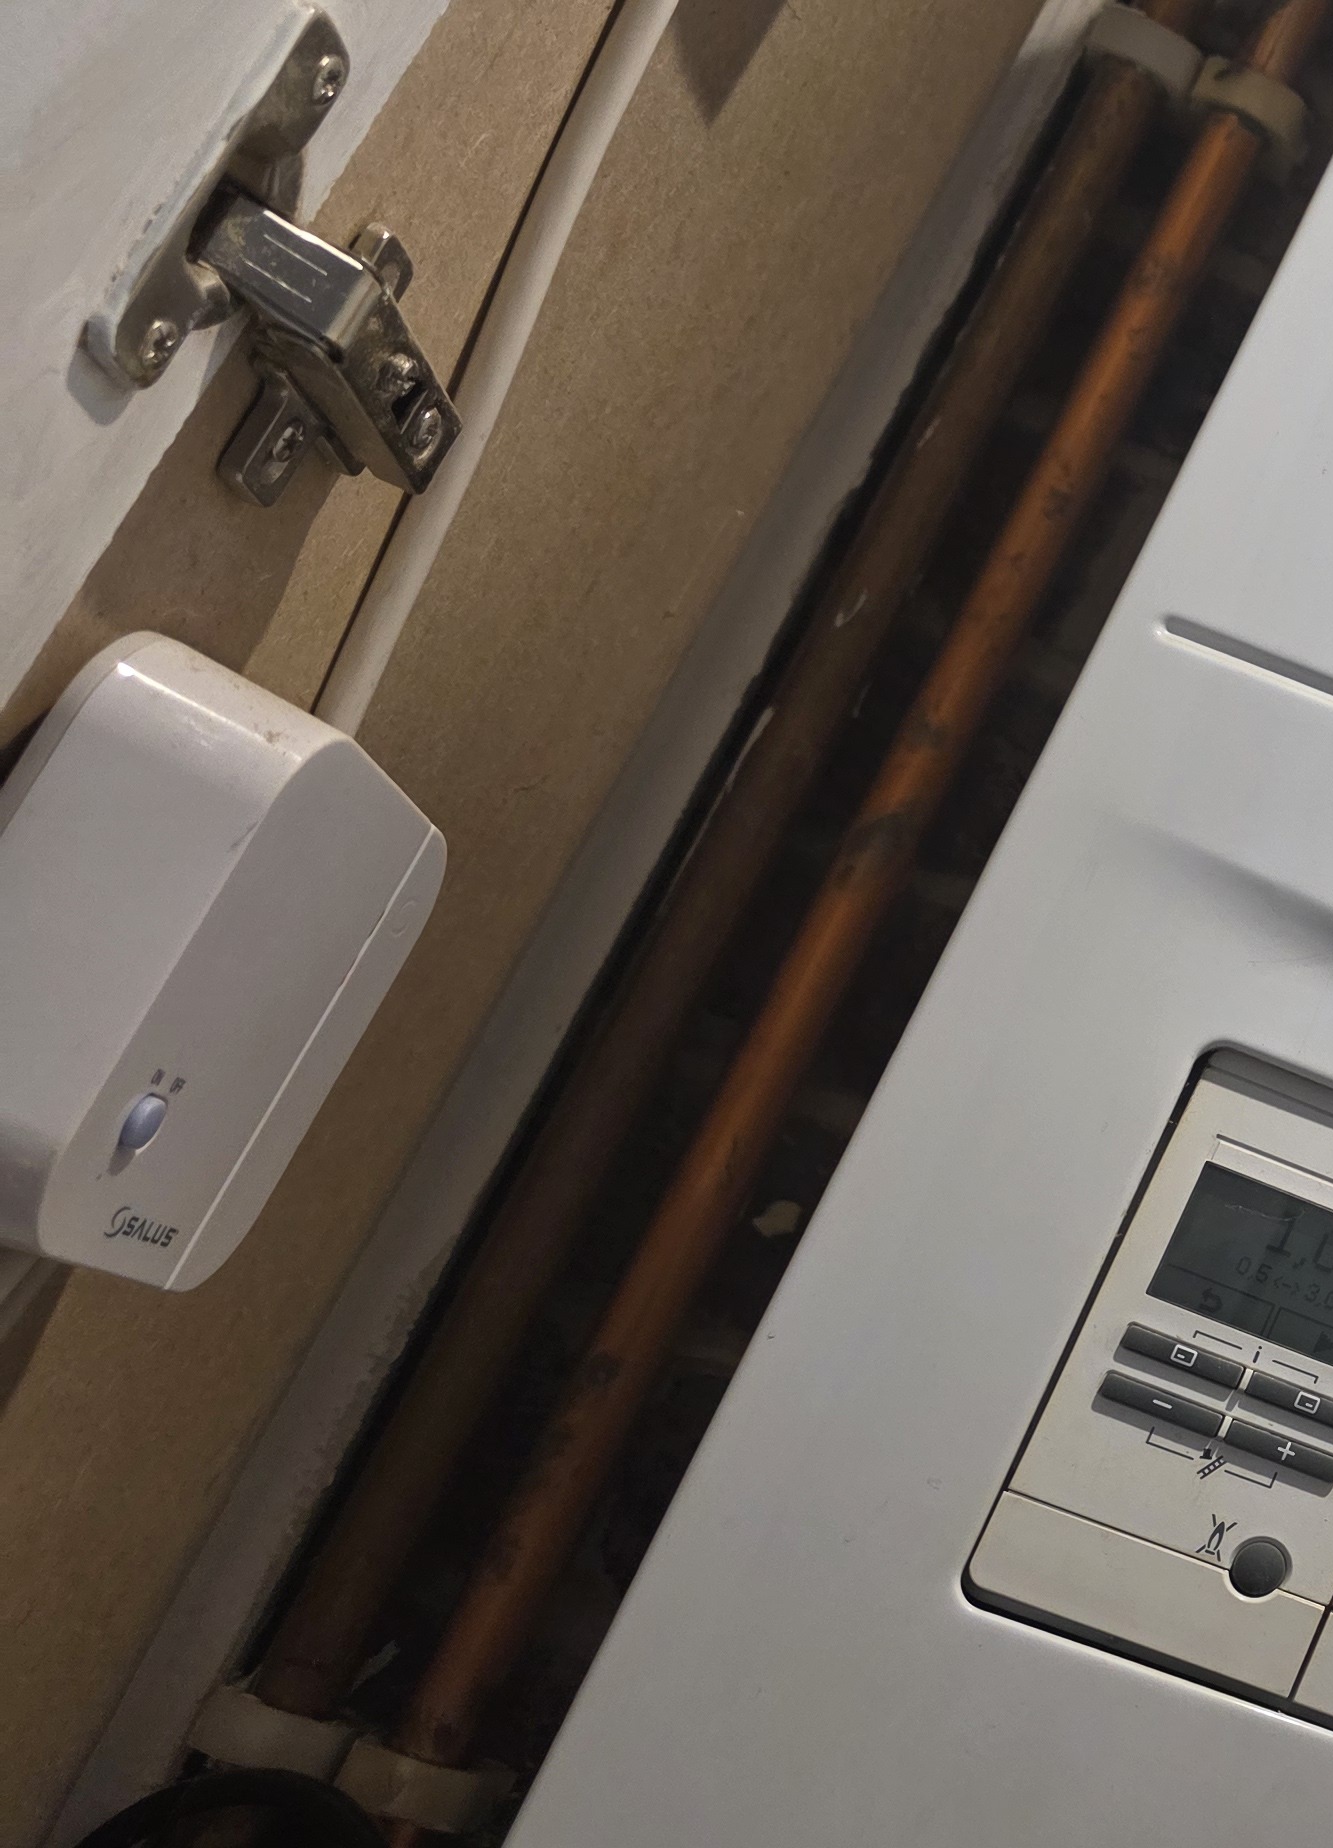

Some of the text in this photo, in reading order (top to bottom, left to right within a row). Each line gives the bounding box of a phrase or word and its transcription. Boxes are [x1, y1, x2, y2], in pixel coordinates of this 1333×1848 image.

[151, 1068, 186, 1096] ON OFF
[122, 1216, 178, 1248] SALUS
